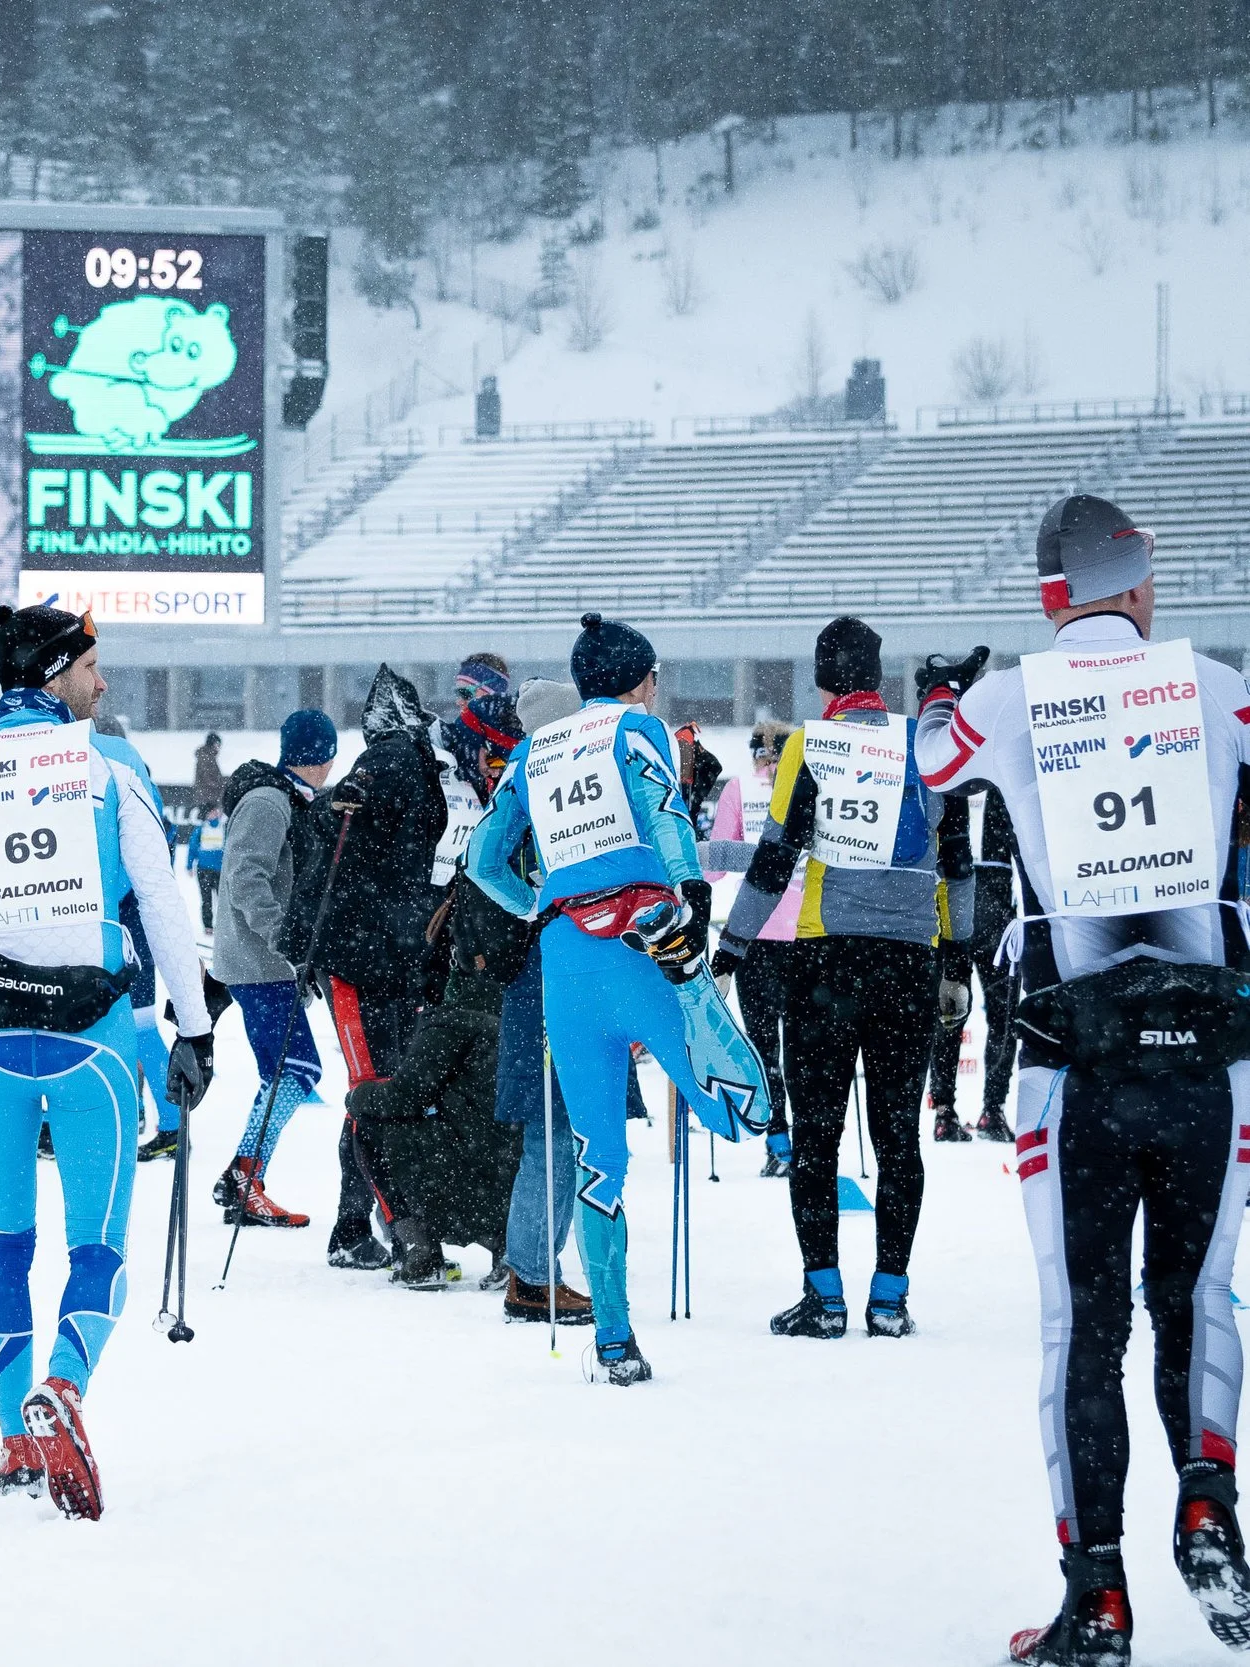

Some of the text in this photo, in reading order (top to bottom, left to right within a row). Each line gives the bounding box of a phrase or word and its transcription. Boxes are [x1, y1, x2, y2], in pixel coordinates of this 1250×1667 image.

[84, 248, 204, 290] 09:52
[27, 468, 252, 529] FINSKI
[27, 530, 252, 556] FINLANDIA-HIIHTO
[66, 590, 247, 616] INTERSPORT
[1068, 652, 1146, 669] WORLDLOPPET
[1122, 681, 1196, 709] renta
[1030, 695, 1106, 722] FINSKI
[579, 714, 620, 734] renta
[1032, 713, 1107, 730] FINLANDIA-HIIHTO
[531, 729, 572, 750] FINSKI
[587, 736, 613, 749] INTER
[1154, 727, 1200, 744] INTER
[586, 744, 612, 756] SPORT
[806, 738, 852, 753] FINSKI
[861, 744, 905, 762] renta
[1036, 737, 1106, 760] VITAMIN
[1155, 738, 1201, 756] SPORT
[30, 750, 88, 769] renta
[527, 752, 564, 770] VITAMIN
[1039, 756, 1080, 774] WELL
[527, 766, 549, 779] WELL
[874, 771, 902, 782] INTER
[52, 780, 88, 793] INTER
[874, 778, 900, 787] SPORT
[52, 790, 88, 803] SPORT
[548, 772, 603, 813] 145
[821, 797, 879, 824] 153
[1093, 786, 1156, 832] 91
[550, 814, 616, 844] SALOMON
[4, 827, 58, 864] 69
[594, 831, 633, 849] Hollola
[816, 830, 879, 852] SALOMON
[546, 843, 586, 868] LAHTI
[1077, 849, 1193, 878] SALOMON
[1064, 886, 1138, 907] LAHTI
[1155, 879, 1210, 898] Hollola
[52, 902, 98, 917] Hollola
[1140, 1030, 1197, 1044] SILVA
